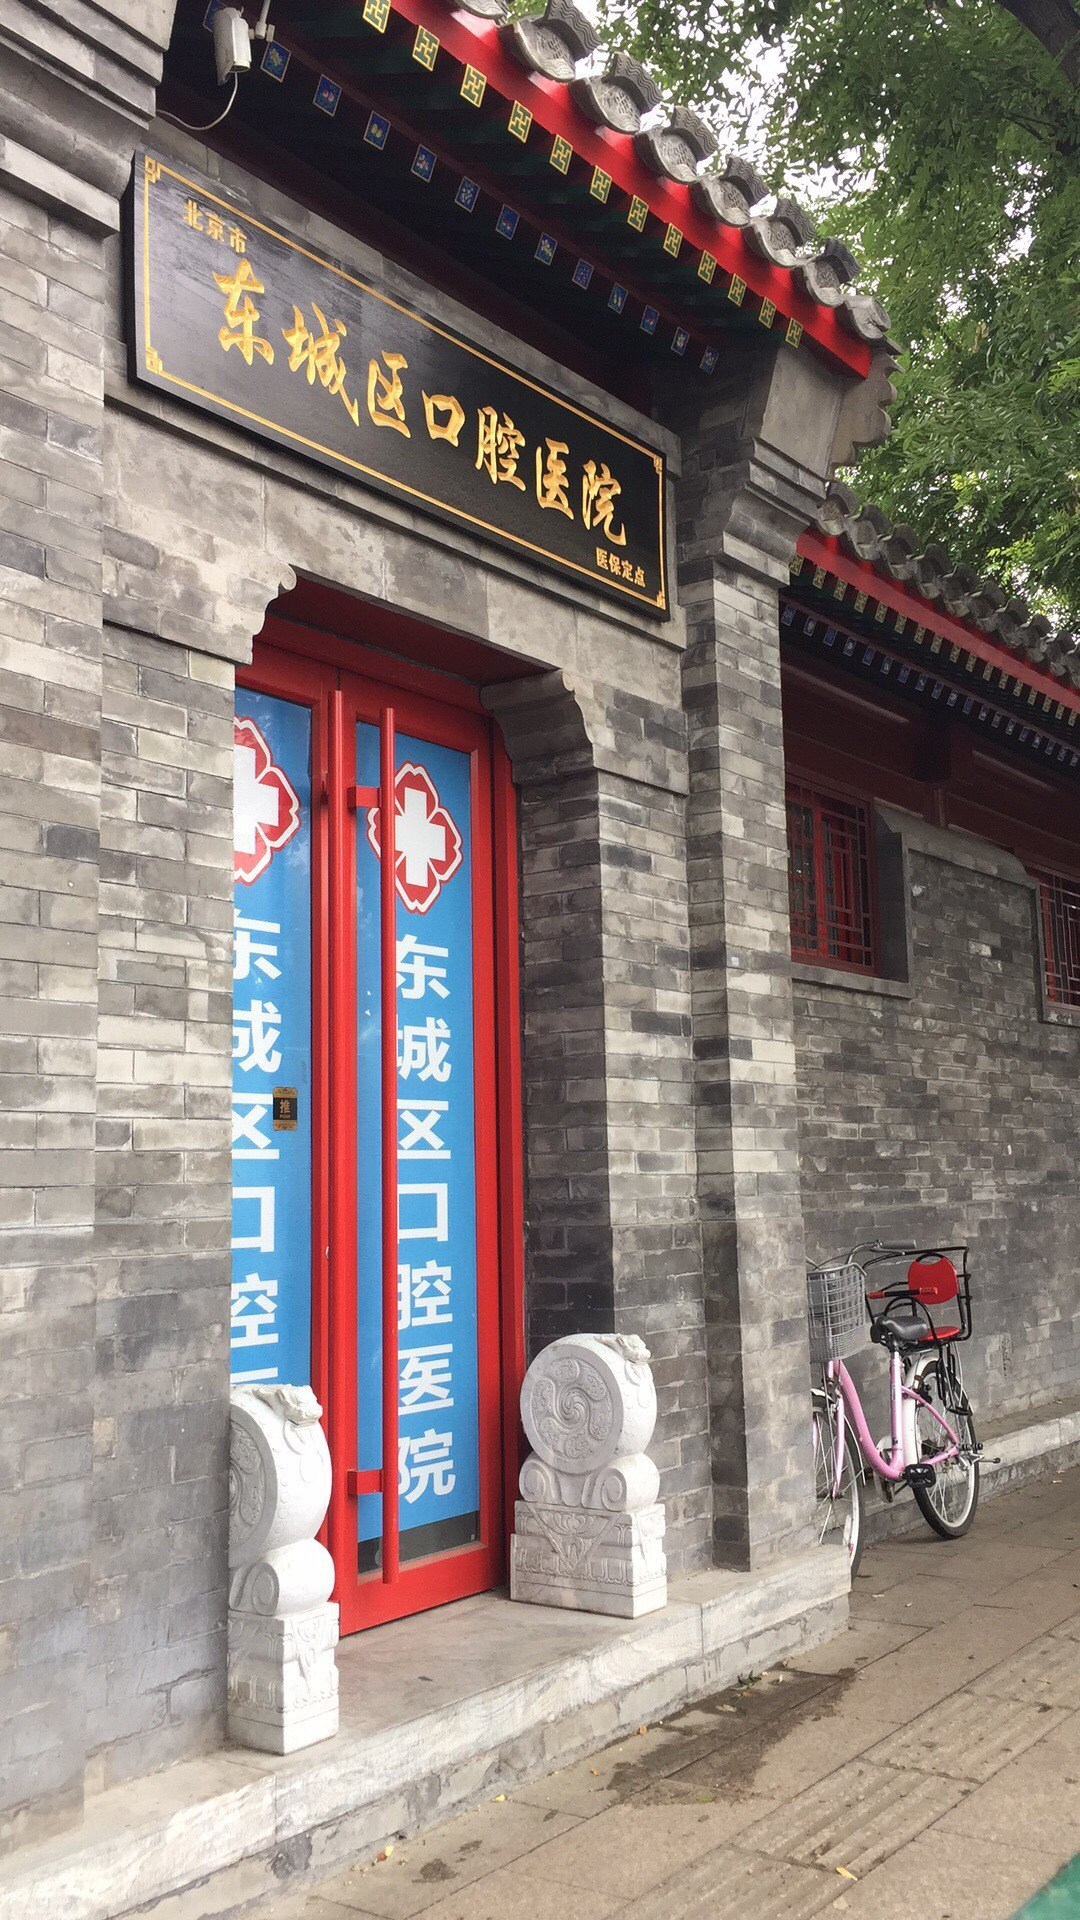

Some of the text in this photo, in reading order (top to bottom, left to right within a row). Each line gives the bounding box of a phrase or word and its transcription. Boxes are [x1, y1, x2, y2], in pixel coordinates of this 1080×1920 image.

[183, 199, 247, 253] 北京市
[213, 259, 627, 546] 东城区口腔医院
[596, 546, 646, 588] 医保定点
[280, 1099, 290, 1113] 推
[396, 933, 456, 1504] 东城区口腔医院
